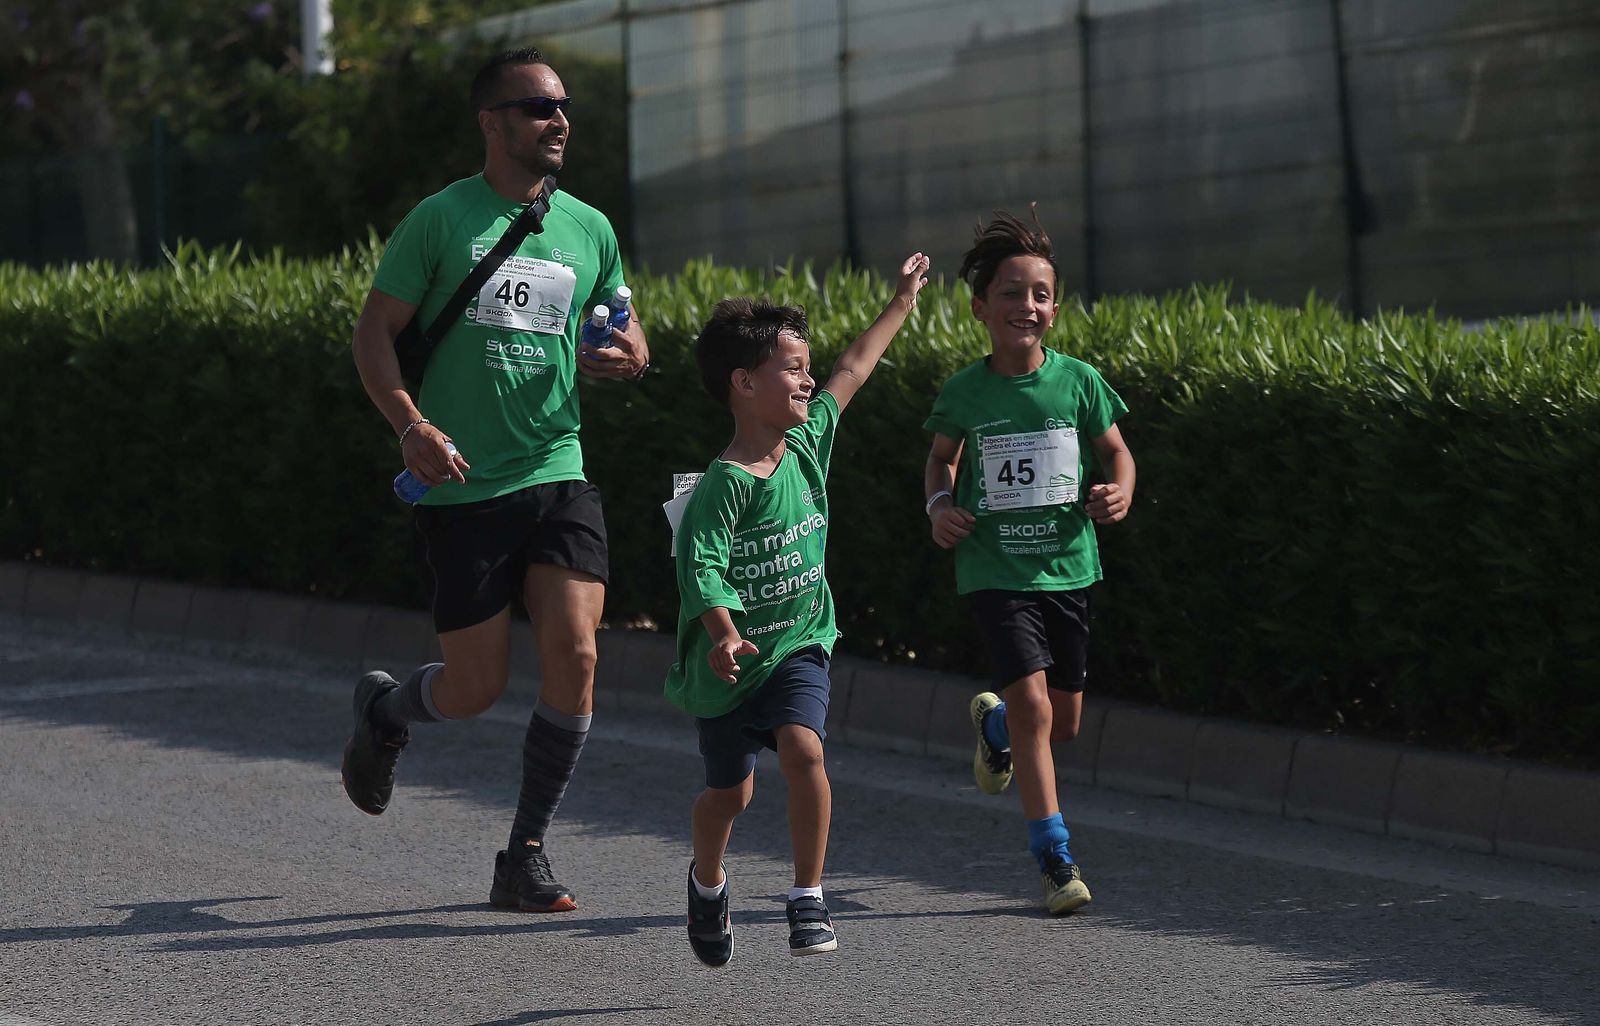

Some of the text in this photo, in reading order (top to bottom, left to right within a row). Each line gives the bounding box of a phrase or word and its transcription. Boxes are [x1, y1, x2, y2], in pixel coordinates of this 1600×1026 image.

[524, 260, 548, 268] marcha
[494, 279, 530, 308] 46
[485, 359, 547, 375] Grazalema Motor
[1024, 432, 1049, 440] marcha
[997, 459, 1036, 487] 45
[730, 512, 826, 558] En marcha
[1041, 544, 1061, 553] Motor
[731, 550, 803, 581] contra
[736, 566, 822, 603] el cáncer
[746, 618, 796, 636] Grazalema
